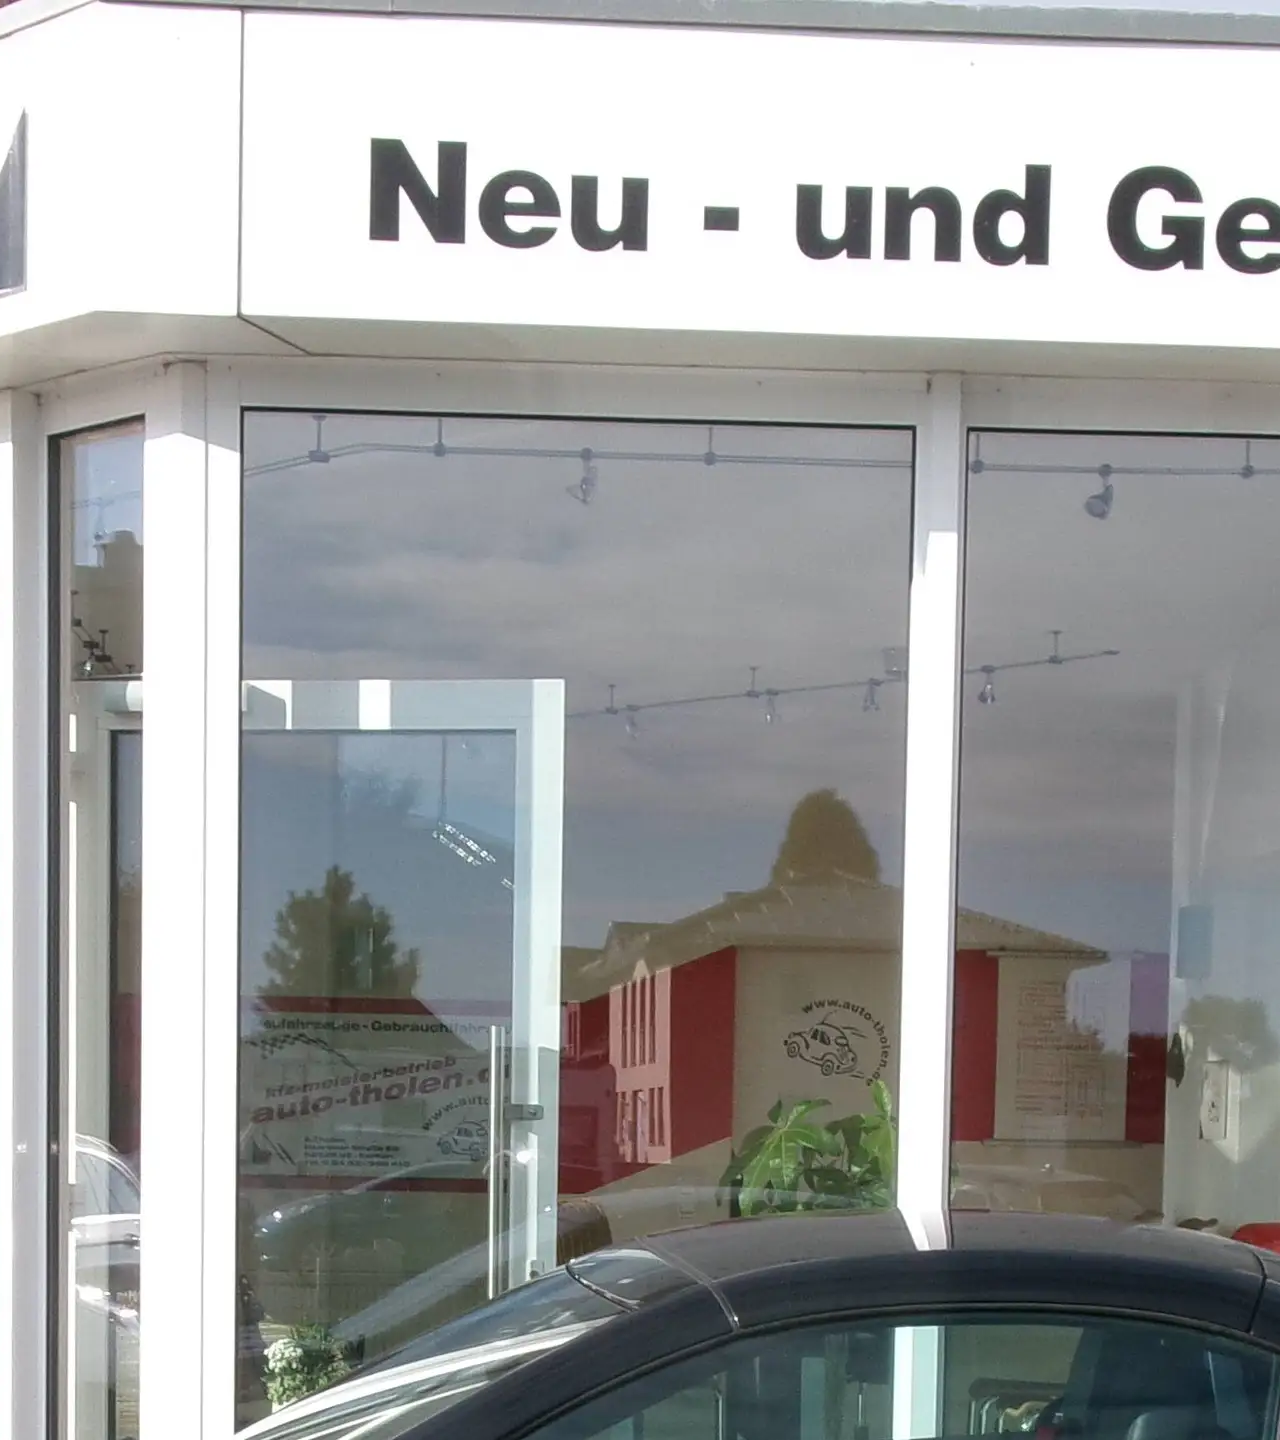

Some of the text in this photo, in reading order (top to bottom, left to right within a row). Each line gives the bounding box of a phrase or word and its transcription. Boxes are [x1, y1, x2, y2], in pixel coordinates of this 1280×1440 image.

[370, 139, 648, 251] Neu
[704, 207, 739, 230] -
[797, 165, 1051, 266] und
[800, 998, 891, 1086] www.auto-tholen.de
